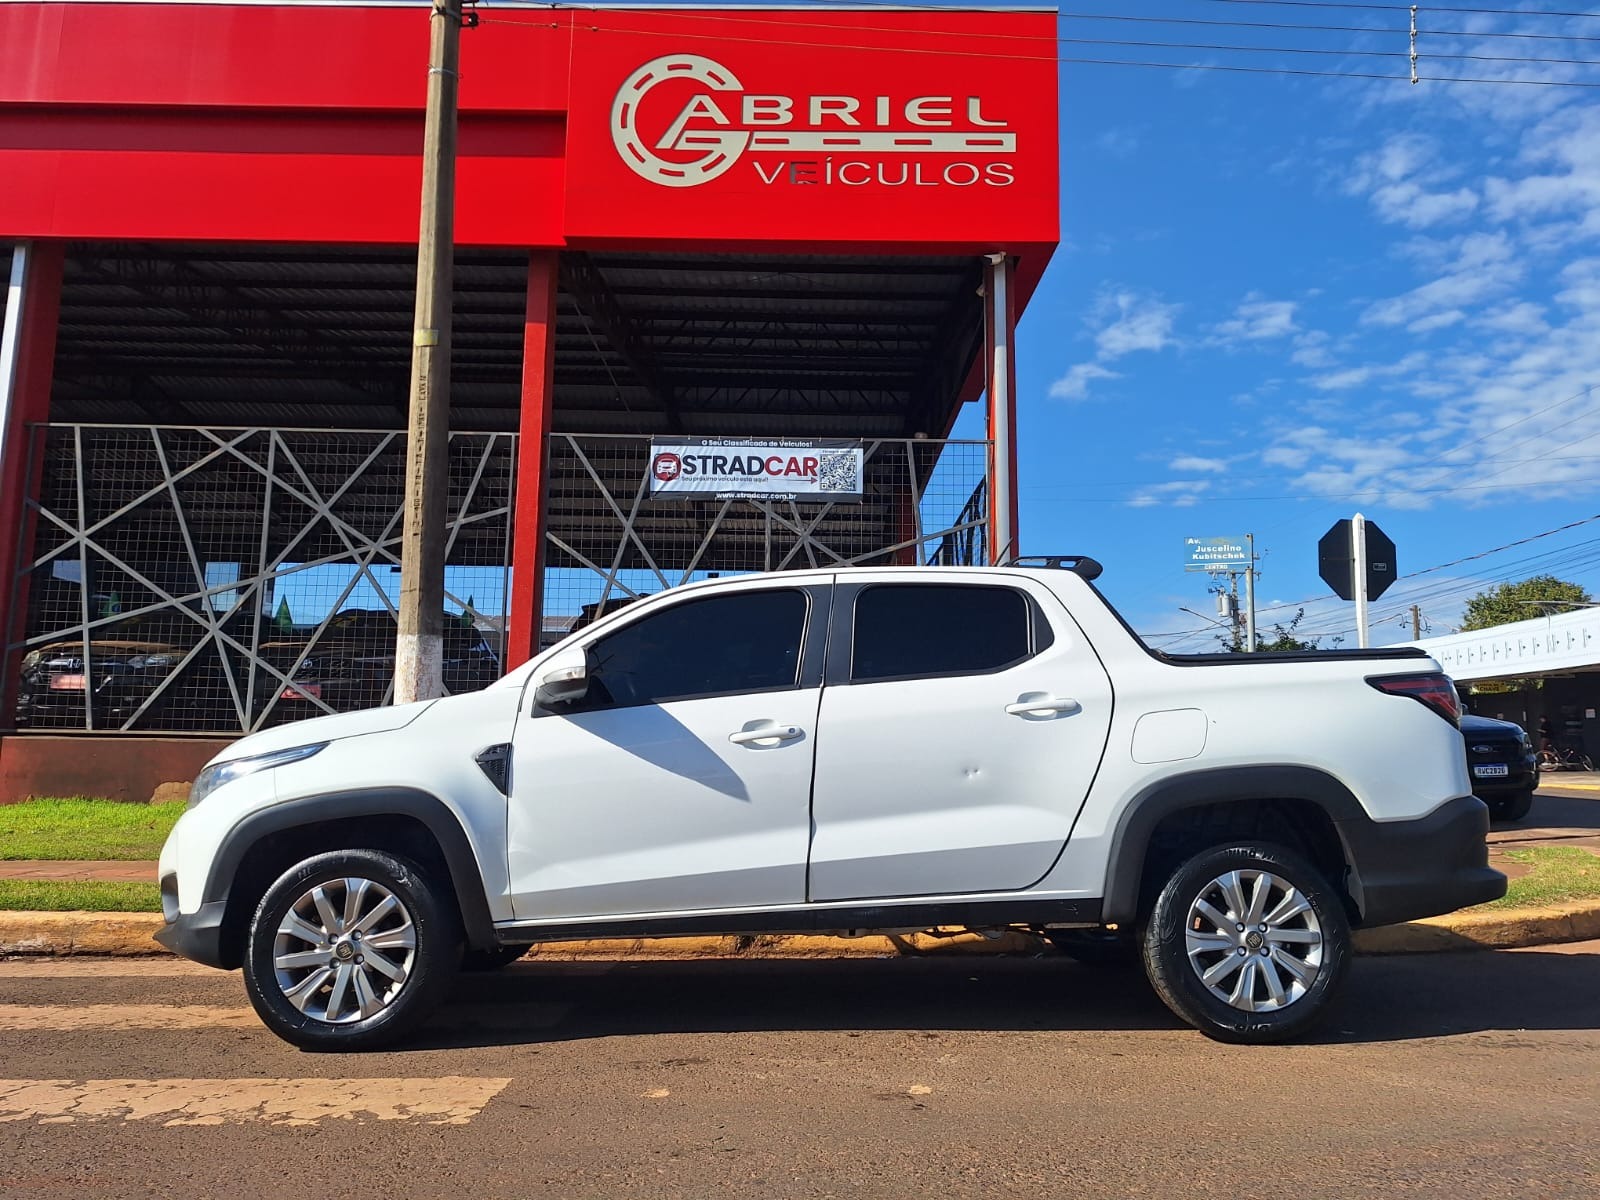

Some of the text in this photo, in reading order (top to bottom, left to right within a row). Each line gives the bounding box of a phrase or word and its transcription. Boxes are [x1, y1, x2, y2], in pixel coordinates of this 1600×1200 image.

[752, 157, 1015, 186] VEÍCULOS
[723, 439, 768, 447] Classificado
[682, 455, 819, 477] STRADCAR
[716, 492, 797, 500] www.stradcar.com.br
[1195, 544, 1242, 553] Juscelino
[1192, 552, 1246, 560] Kubitschek
